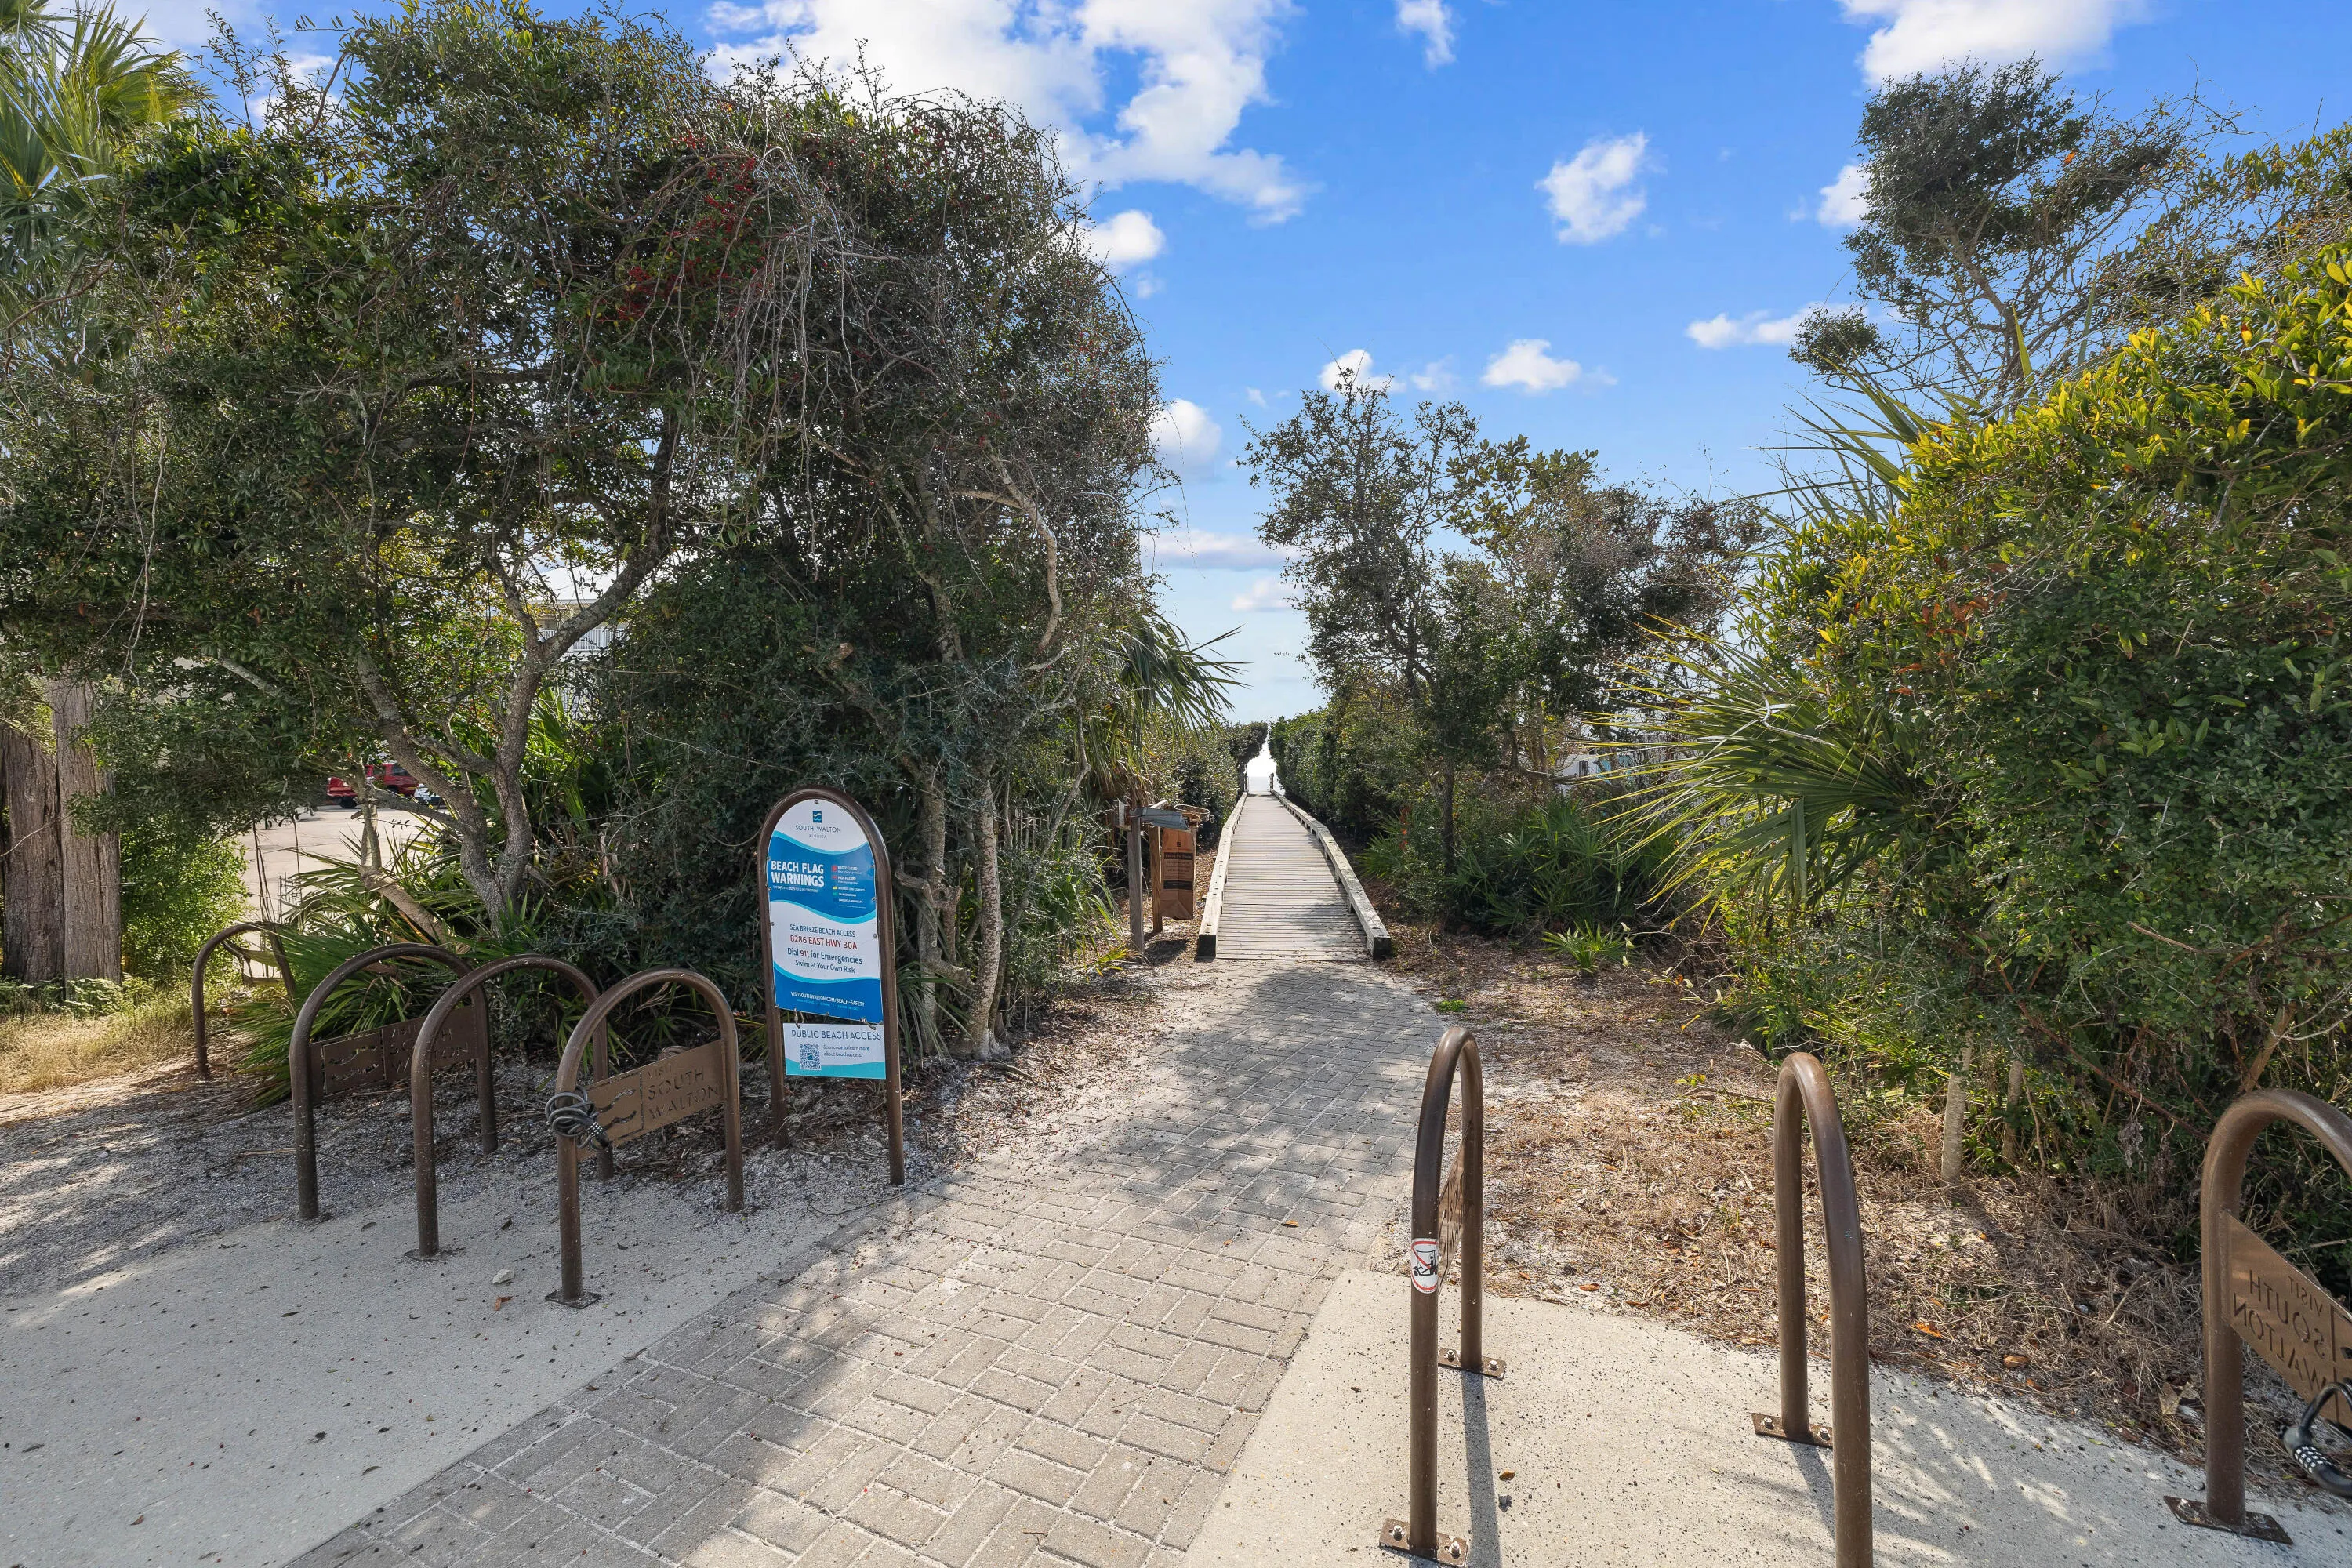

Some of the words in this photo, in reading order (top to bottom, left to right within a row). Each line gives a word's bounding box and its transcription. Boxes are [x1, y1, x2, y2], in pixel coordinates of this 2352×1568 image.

[771, 861, 799, 873] BEACH
[801, 863, 824, 874] FLAG
[771, 871, 825, 887] WARNINGS
[789, 935, 808, 943] 8286
[808, 937, 825, 946] EAST
[826, 938, 841, 948] HWY
[844, 941, 858, 949] 30A
[787, 947, 799, 956] Dial
[821, 952, 862, 964] Emergencies
[791, 1029, 819, 1039] PUBLIC
[821, 1030, 848, 1040] BEACH
[850, 1031, 882, 1040] ACCESS
[648, 1065, 672, 1080] VISIT
[648, 1068, 705, 1100] SOUTH
[649, 1084, 719, 1121] WALTON
